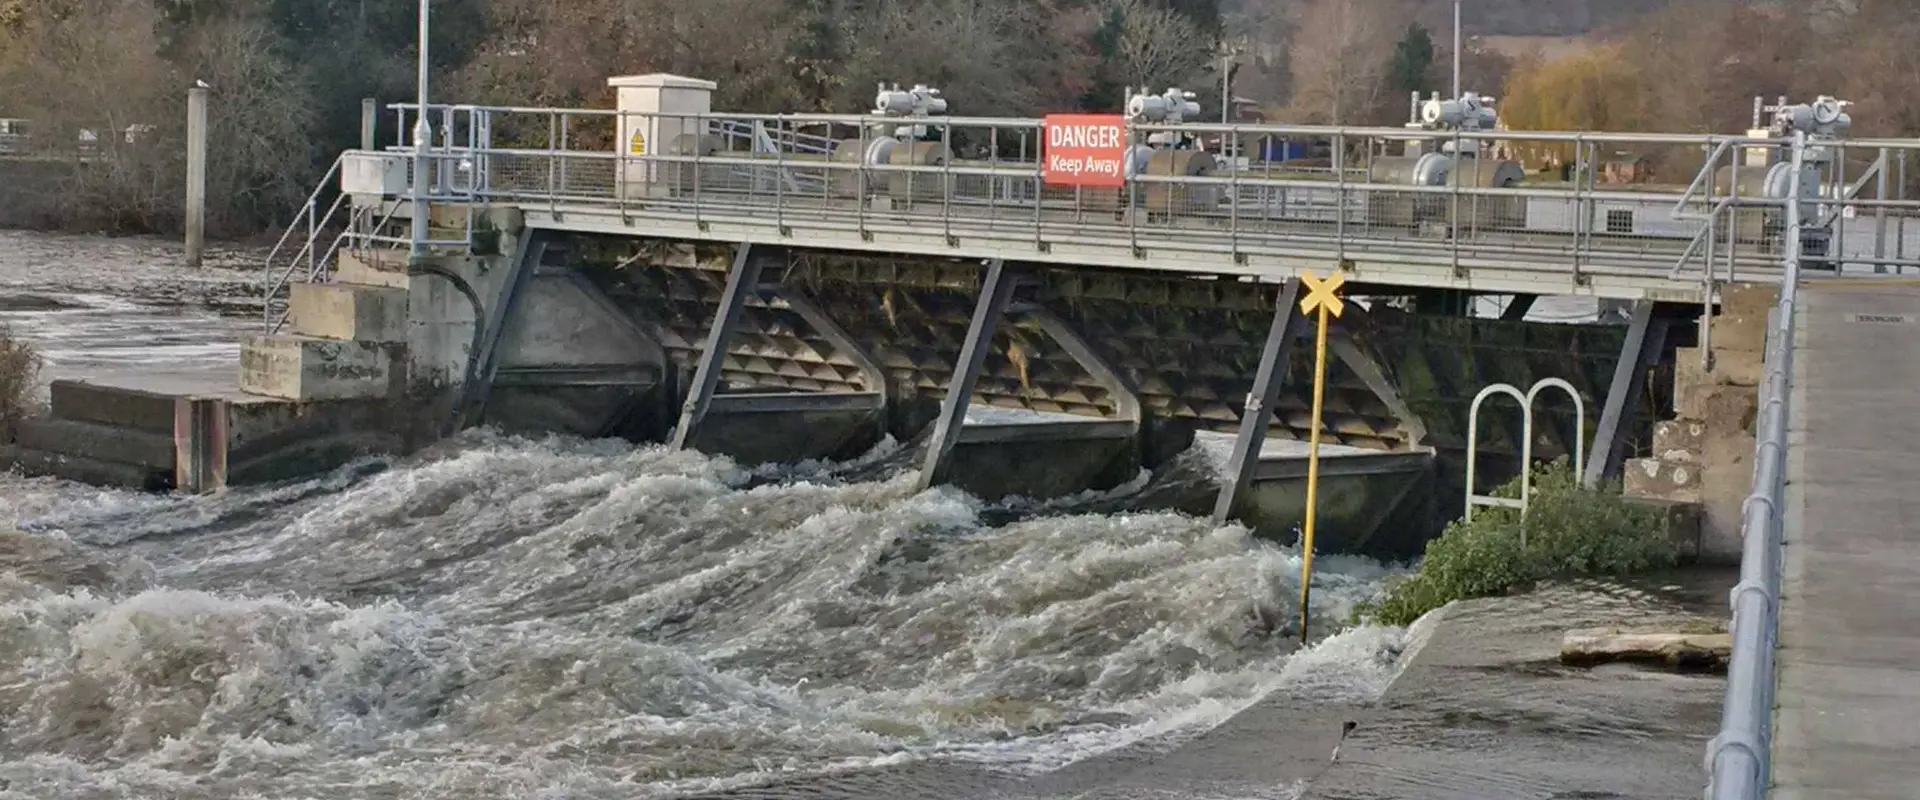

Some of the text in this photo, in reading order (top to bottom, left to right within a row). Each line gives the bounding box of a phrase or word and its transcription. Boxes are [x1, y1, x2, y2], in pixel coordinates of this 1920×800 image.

[1051, 125, 1120, 148] DANGER
[1051, 155, 1120, 177] Keep Away
